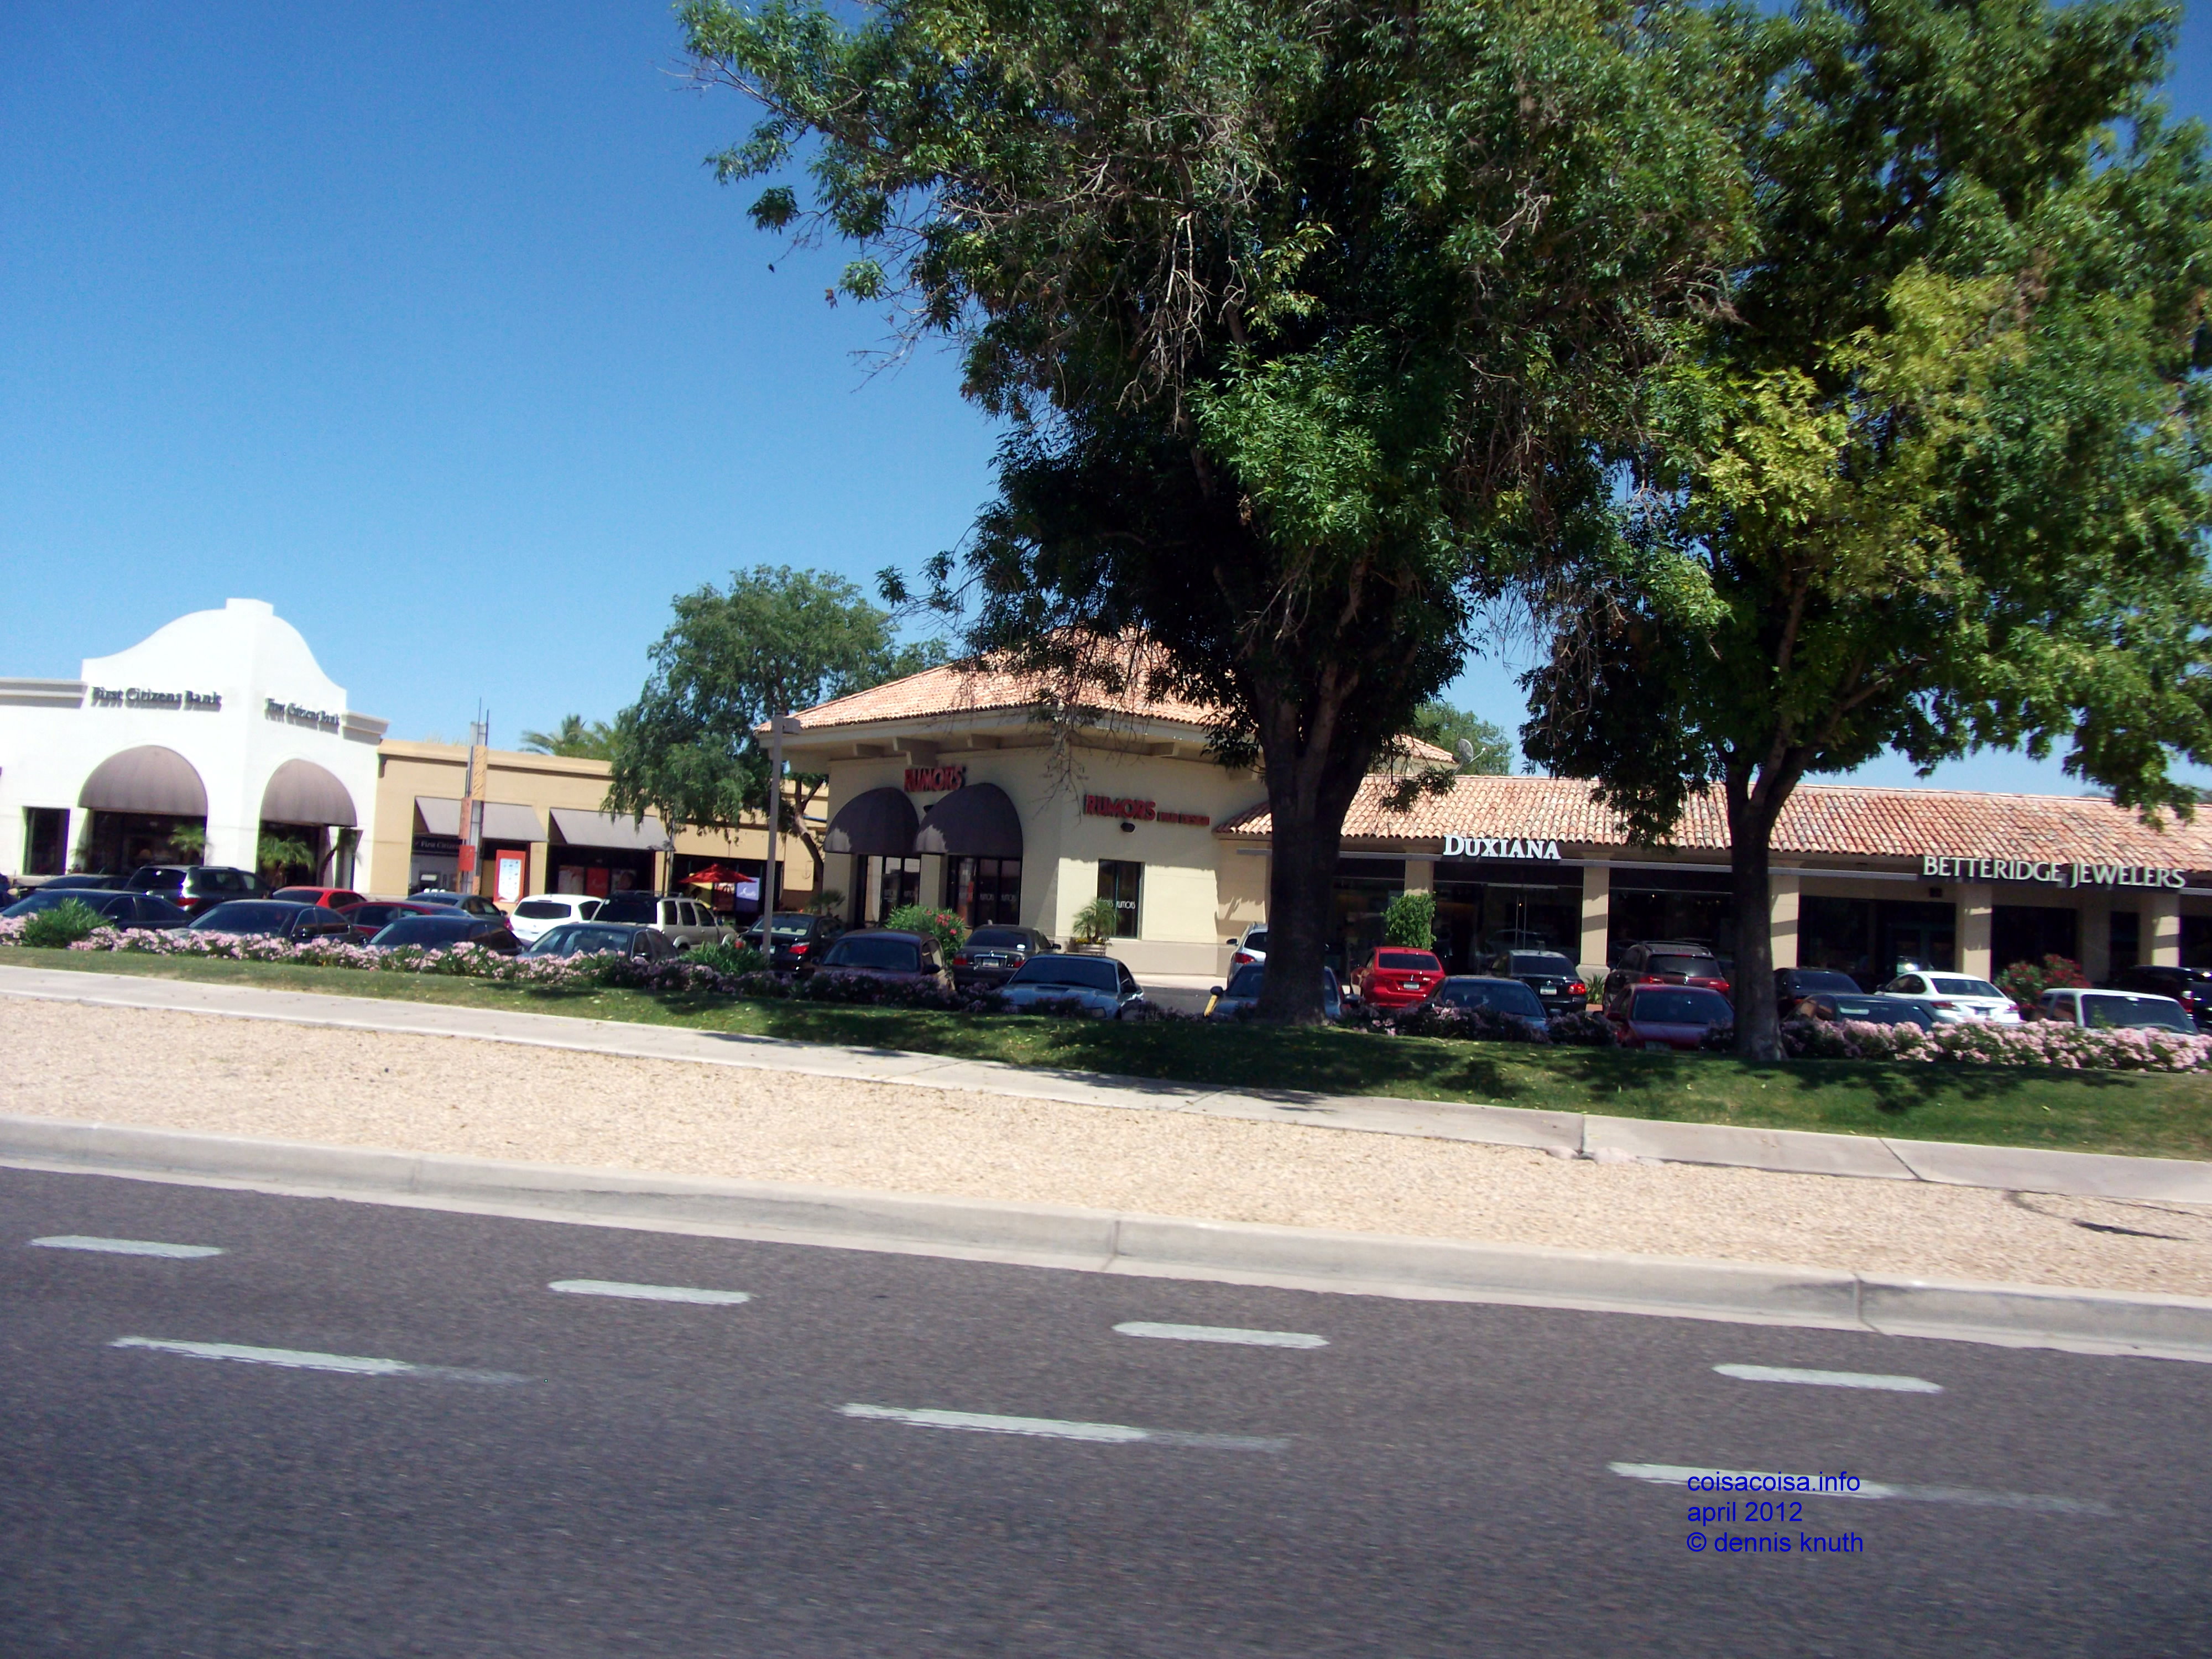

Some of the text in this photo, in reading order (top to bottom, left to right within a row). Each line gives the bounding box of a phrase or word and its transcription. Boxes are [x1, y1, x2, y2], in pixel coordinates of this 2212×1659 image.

[91, 686, 222, 705] First Citizens Bank
[265, 698, 340, 726] First Citizens Bank
[904, 766, 963, 792] RUMORS
[1085, 794, 1156, 821] RUMORS
[1923, 855, 2186, 889] BETTERIDGE JEWELERS
